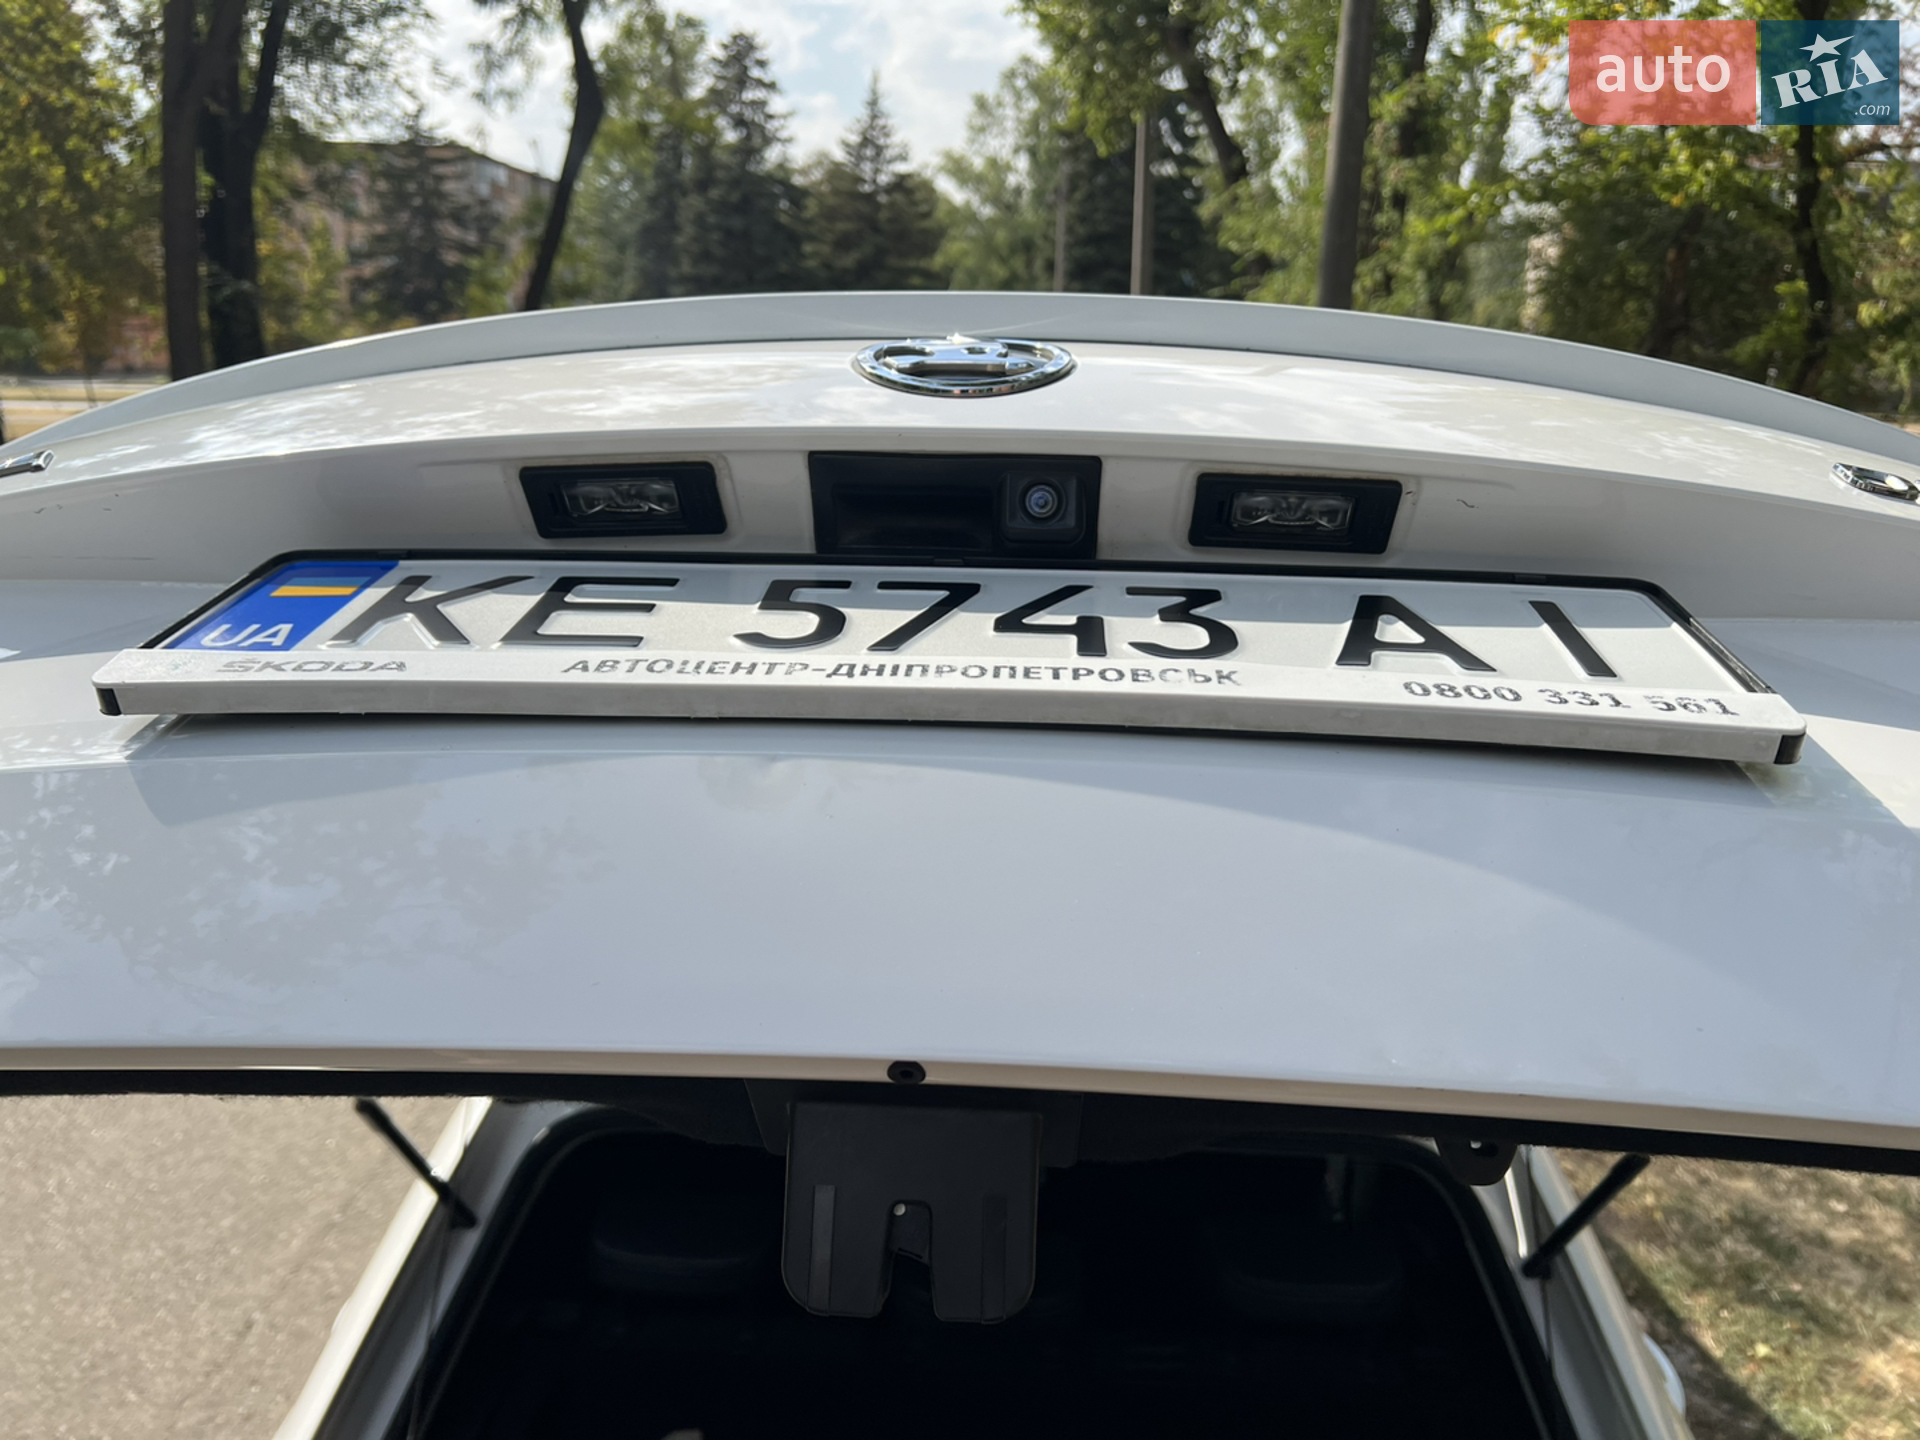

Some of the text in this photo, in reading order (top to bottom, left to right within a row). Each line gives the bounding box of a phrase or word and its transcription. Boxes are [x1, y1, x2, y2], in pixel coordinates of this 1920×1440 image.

[200, 622, 294, 647] UA
[327, 575, 1618, 678] KE 5743 AI
[1402, 680, 1741, 717] 0800 331 561
